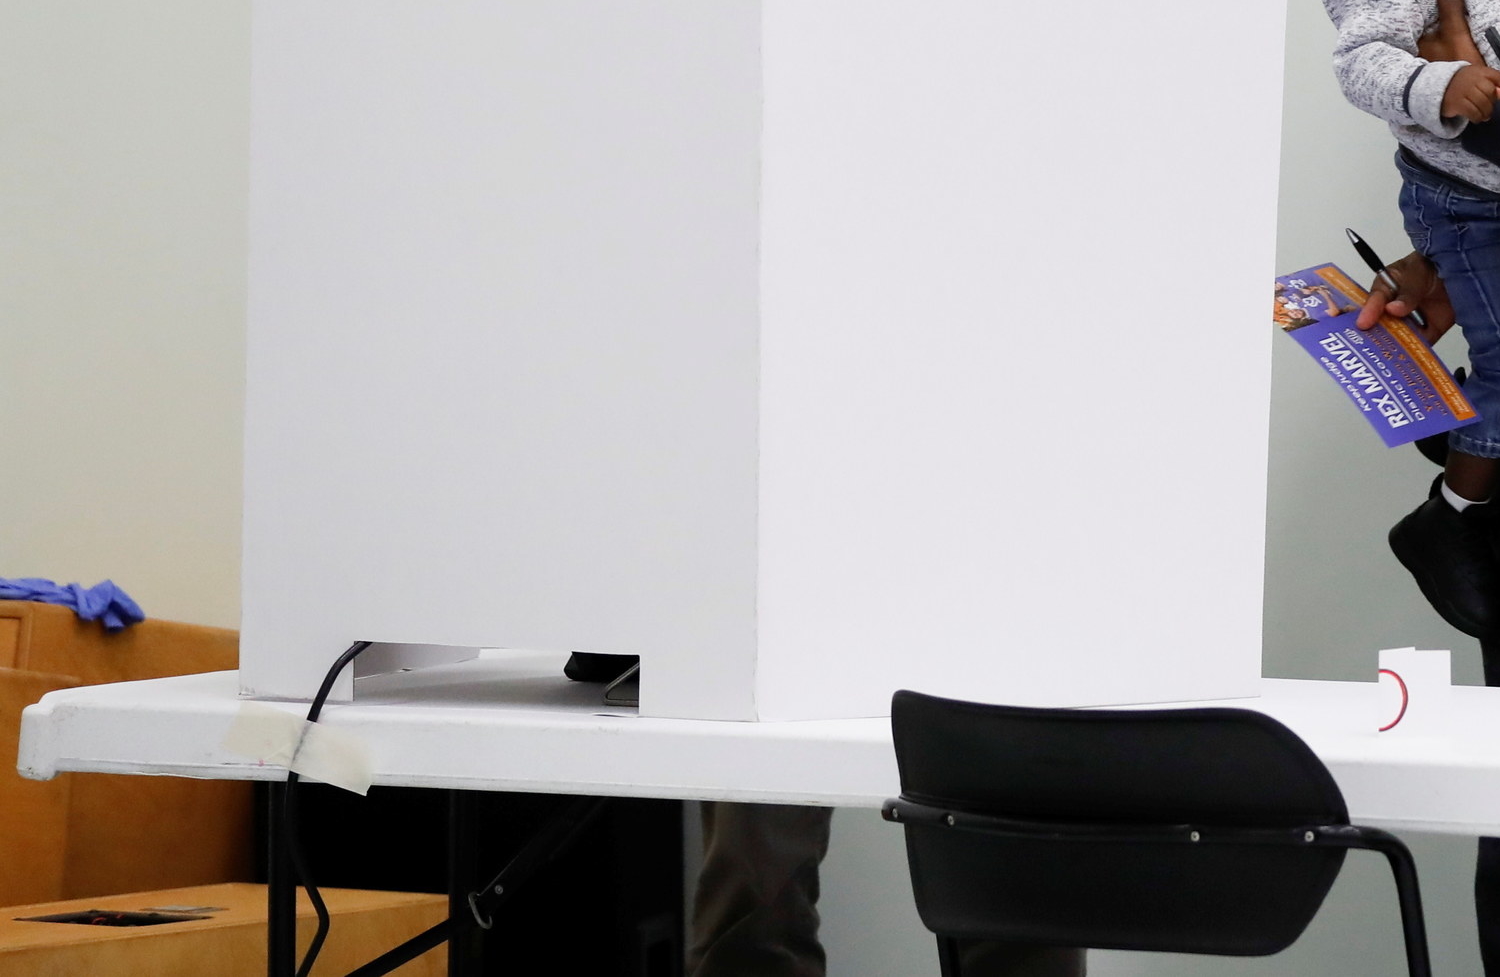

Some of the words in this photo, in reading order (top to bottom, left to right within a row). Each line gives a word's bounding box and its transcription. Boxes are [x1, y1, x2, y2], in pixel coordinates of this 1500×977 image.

[1318, 332, 1384, 394] MARVEL
[1320, 356, 1352, 384] Judge
[1362, 347, 1392, 378] Court
[1346, 384, 1372, 412] Keep
[1371, 393, 1410, 429] REX
[1390, 380, 1426, 421] District
